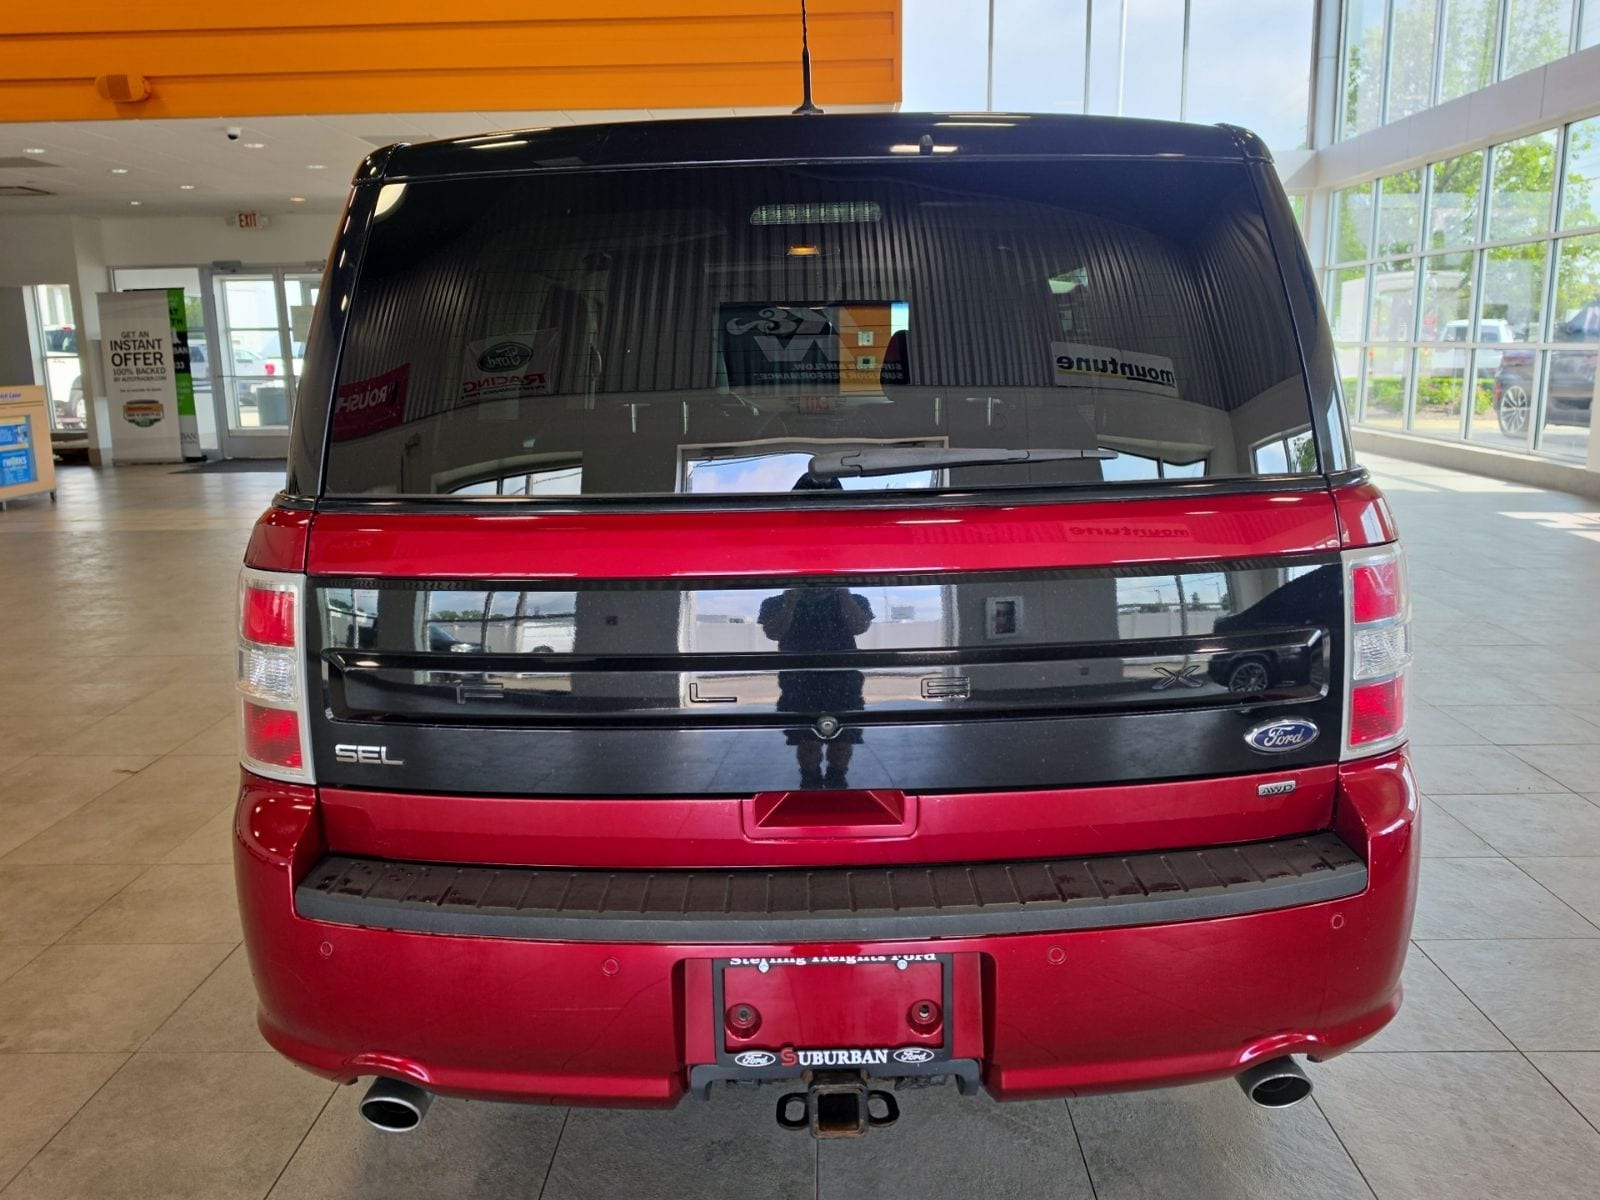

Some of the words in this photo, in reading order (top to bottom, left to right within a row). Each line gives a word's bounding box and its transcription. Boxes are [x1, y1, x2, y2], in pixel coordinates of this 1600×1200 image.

[239, 213, 257, 228] EXIT
[110, 338, 162, 351] INSTANT
[111, 352, 164, 367] OFFER
[113, 367, 133, 376] 100%
[136, 367, 166, 375] BACKED
[335, 744, 404, 766] SEL
[1260, 783, 1294, 795] AWD
[781, 1047, 889, 1067] SUBURBAN
